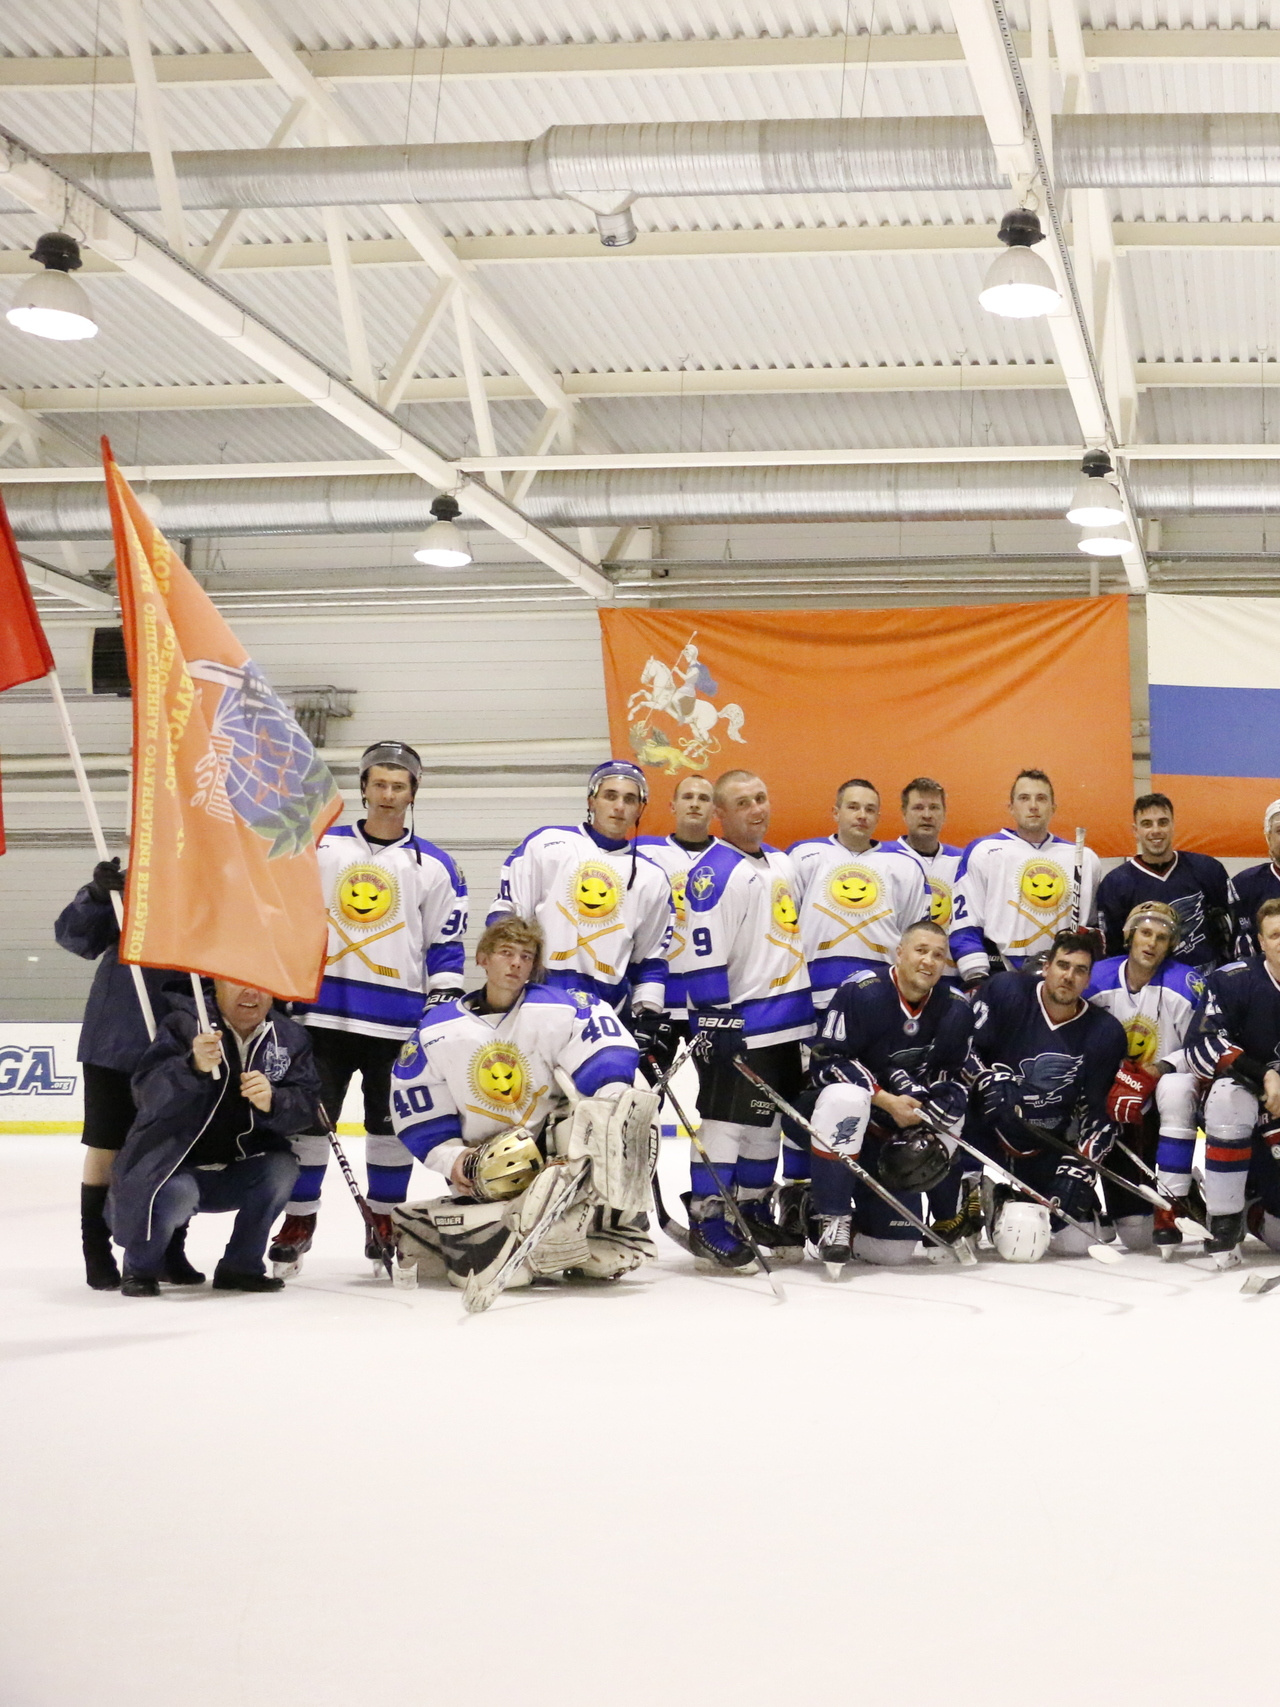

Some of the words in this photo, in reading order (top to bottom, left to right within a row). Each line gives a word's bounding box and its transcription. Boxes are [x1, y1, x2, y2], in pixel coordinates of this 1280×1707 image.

[692, 927, 713, 957] 9
[581, 1016, 622, 1044] 40
[394, 1085, 434, 1119] 40
[1055, 1165, 1097, 1188] CCM
